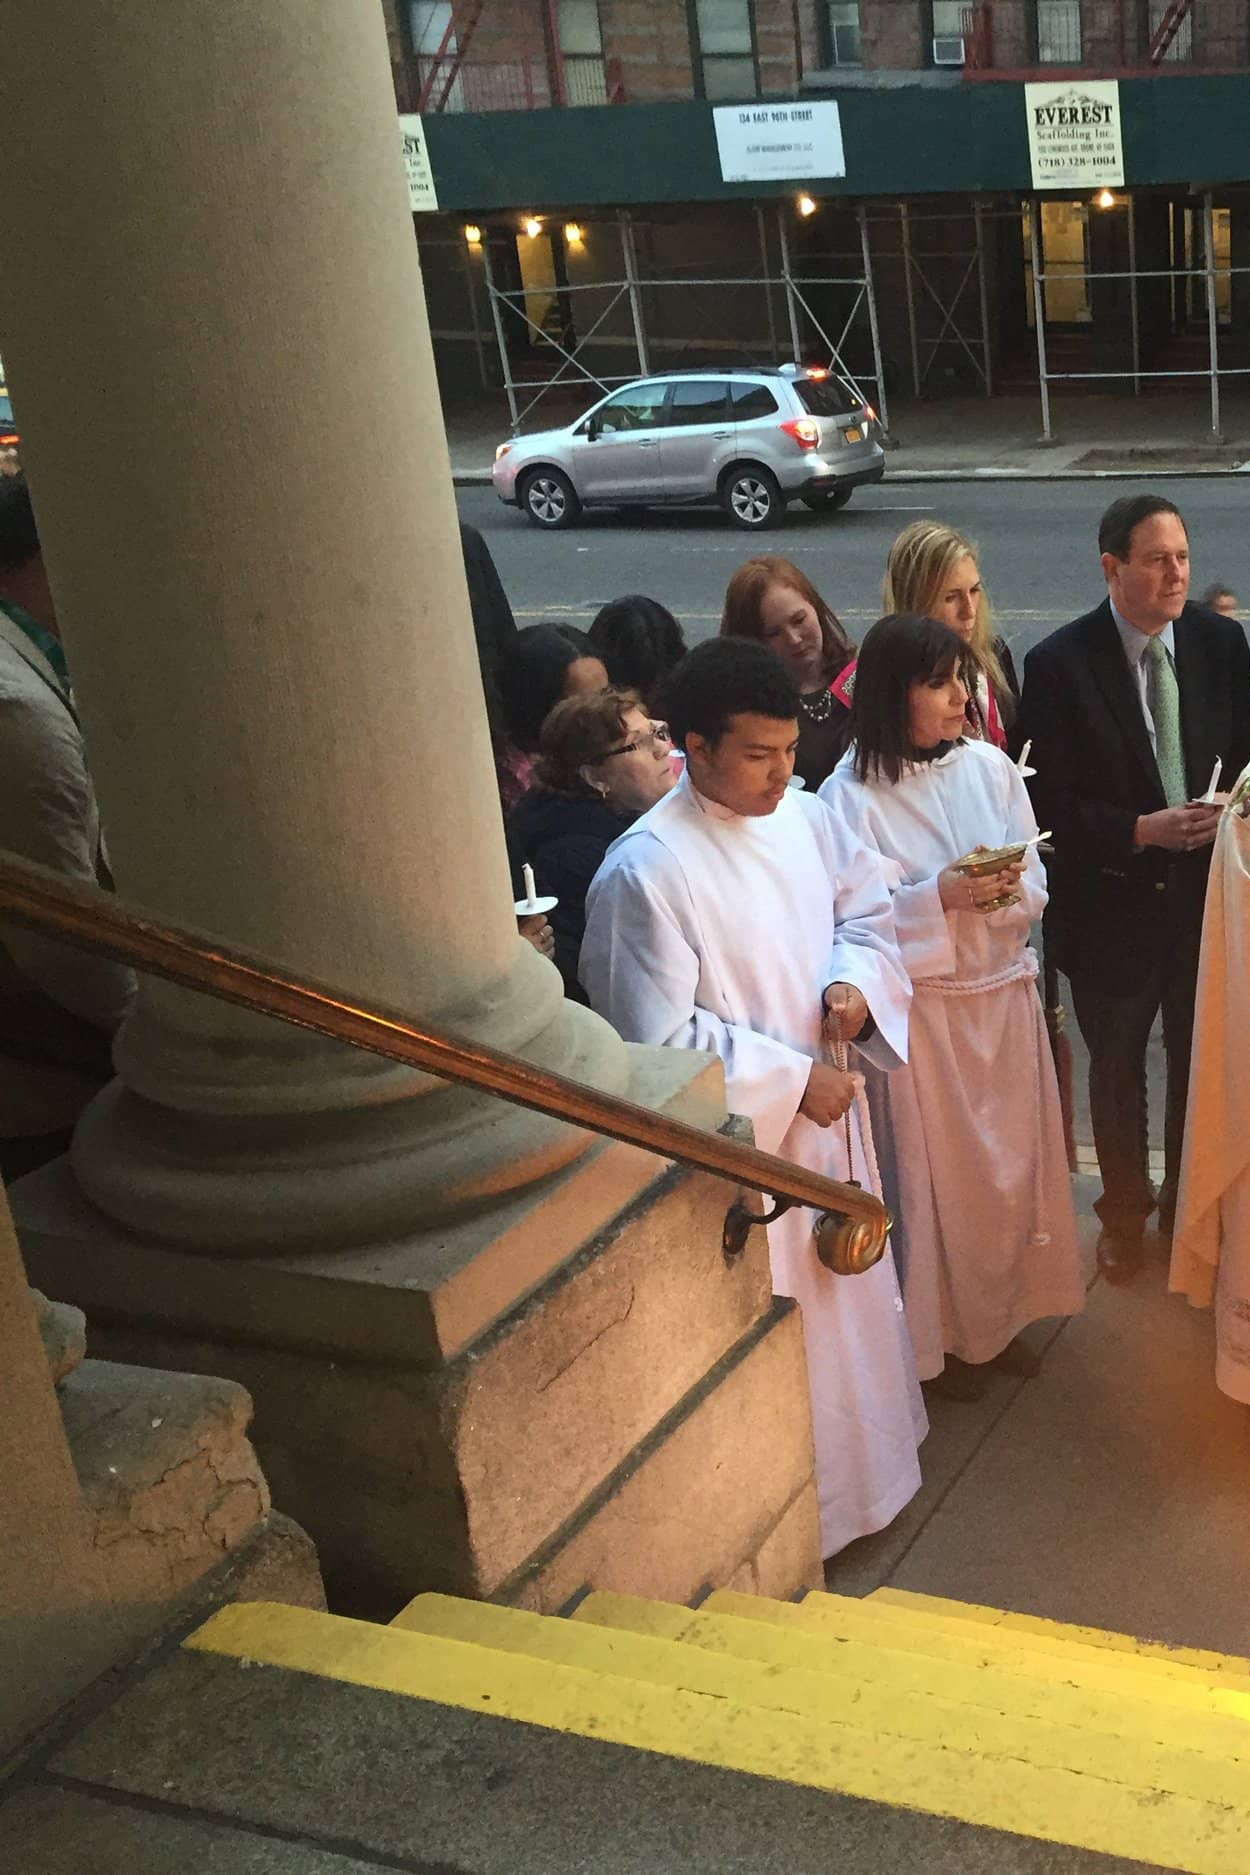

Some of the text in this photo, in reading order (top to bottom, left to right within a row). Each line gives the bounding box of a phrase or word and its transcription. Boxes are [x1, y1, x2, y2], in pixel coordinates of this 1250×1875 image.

[753, 110, 769, 123] EAST
[791, 108, 813, 121] STREET
[1034, 105, 1113, 126] EVEREST
[1037, 128, 1114, 141] Scaffolding Inc.
[1038, 155, 1117, 168] (718) 328-1004
